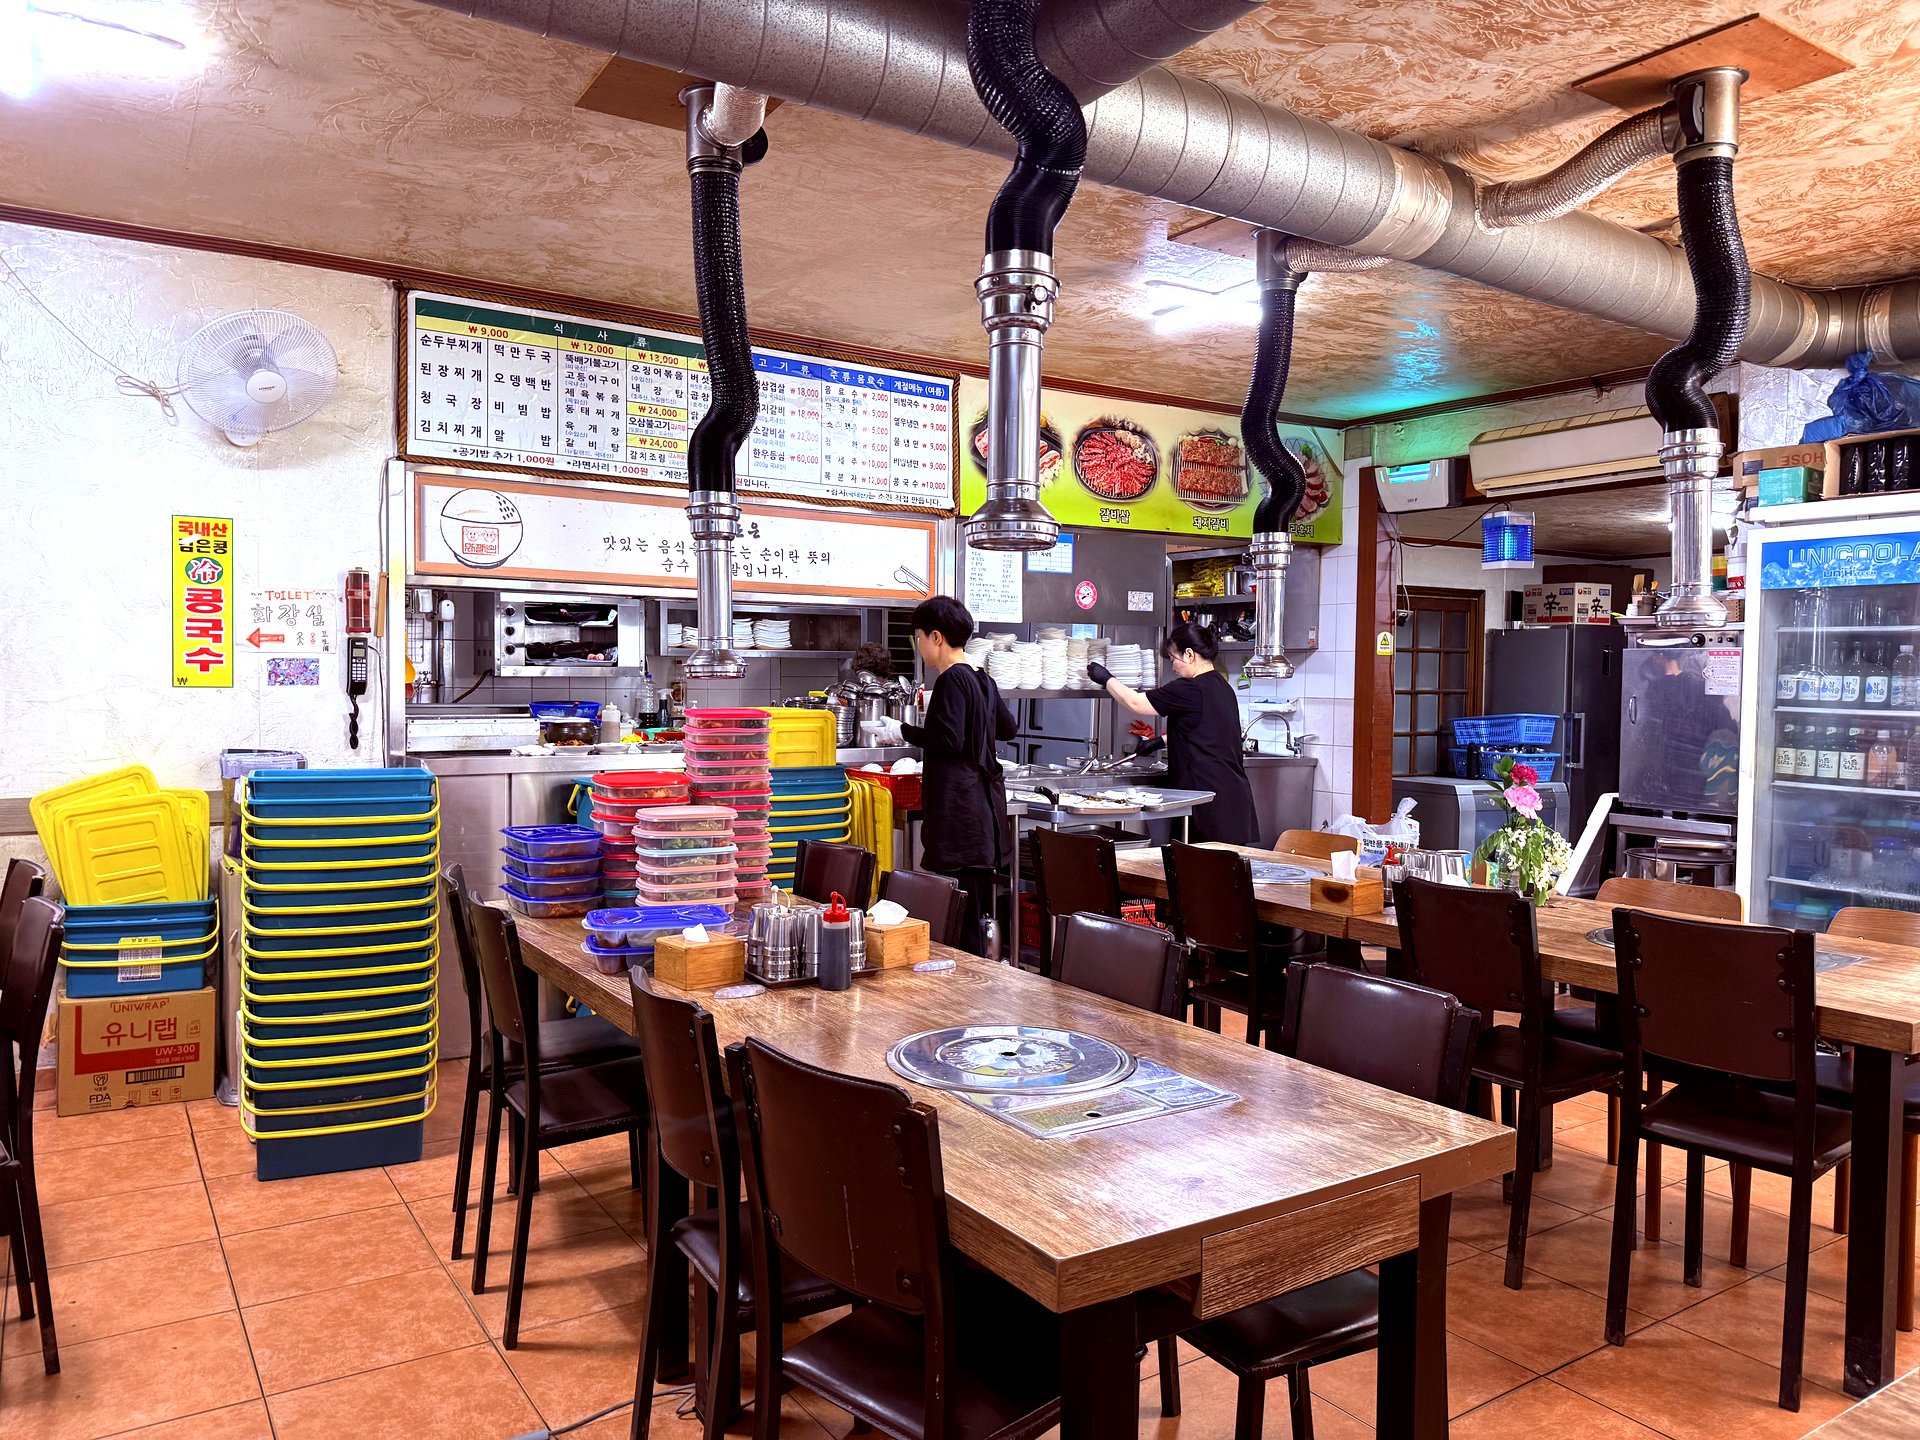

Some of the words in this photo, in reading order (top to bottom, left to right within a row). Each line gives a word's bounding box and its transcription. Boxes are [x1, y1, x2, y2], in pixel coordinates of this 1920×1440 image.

[420, 334, 481, 354] 순두부찌개
[565, 354, 620, 371] 뚝배기불고기
[565, 371, 620, 387] 고등어구이
[757, 380, 785, 394] 삼겹살
[894, 381, 923, 394] 계절메뉴
[894, 397, 920, 409] 비빔국수
[930, 404, 947, 412] 9,000
[649, 407, 678, 418] 24,000
[628, 417, 671, 431] 오삼불고기
[930, 423, 947, 432] 9,000
[753, 426, 785, 440] 소갈비살
[649, 438, 678, 449] 24,000
[930, 443, 947, 452] 9,000
[753, 448, 785, 461] 한우등심
[797, 454, 819, 465] 60,000
[493, 451, 513, 462] 추가
[517, 454, 555, 466] 1,000원
[613, 464, 649, 477] 1,000원
[930, 462, 946, 471] 9,000
[1100, 508, 1130, 524] 갈비살
[179, 520, 228, 538] 국내산
[1193, 516, 1230, 532] 돼지갈비
[603, 536, 649, 553] 맛있는
[760, 547, 800, 564] 손이란
[807, 550, 831, 565] 뜻의
[191, 560, 219, 582] 冷
[661, 557, 690, 574] 순수
[265, 590, 312, 601] TOILET
[251, 603, 324, 626] 화장실
[185, 587, 224, 672] 콩국수
[1363, 838, 1382, 849] 일반용
[1364, 846, 1385, 855] General
[113, 1001, 166, 1013] UNIWRAP
[101, 1017, 177, 1047] 유니랩
[156, 1045, 195, 1056] UW-300
[89, 1093, 112, 1104] FDA
